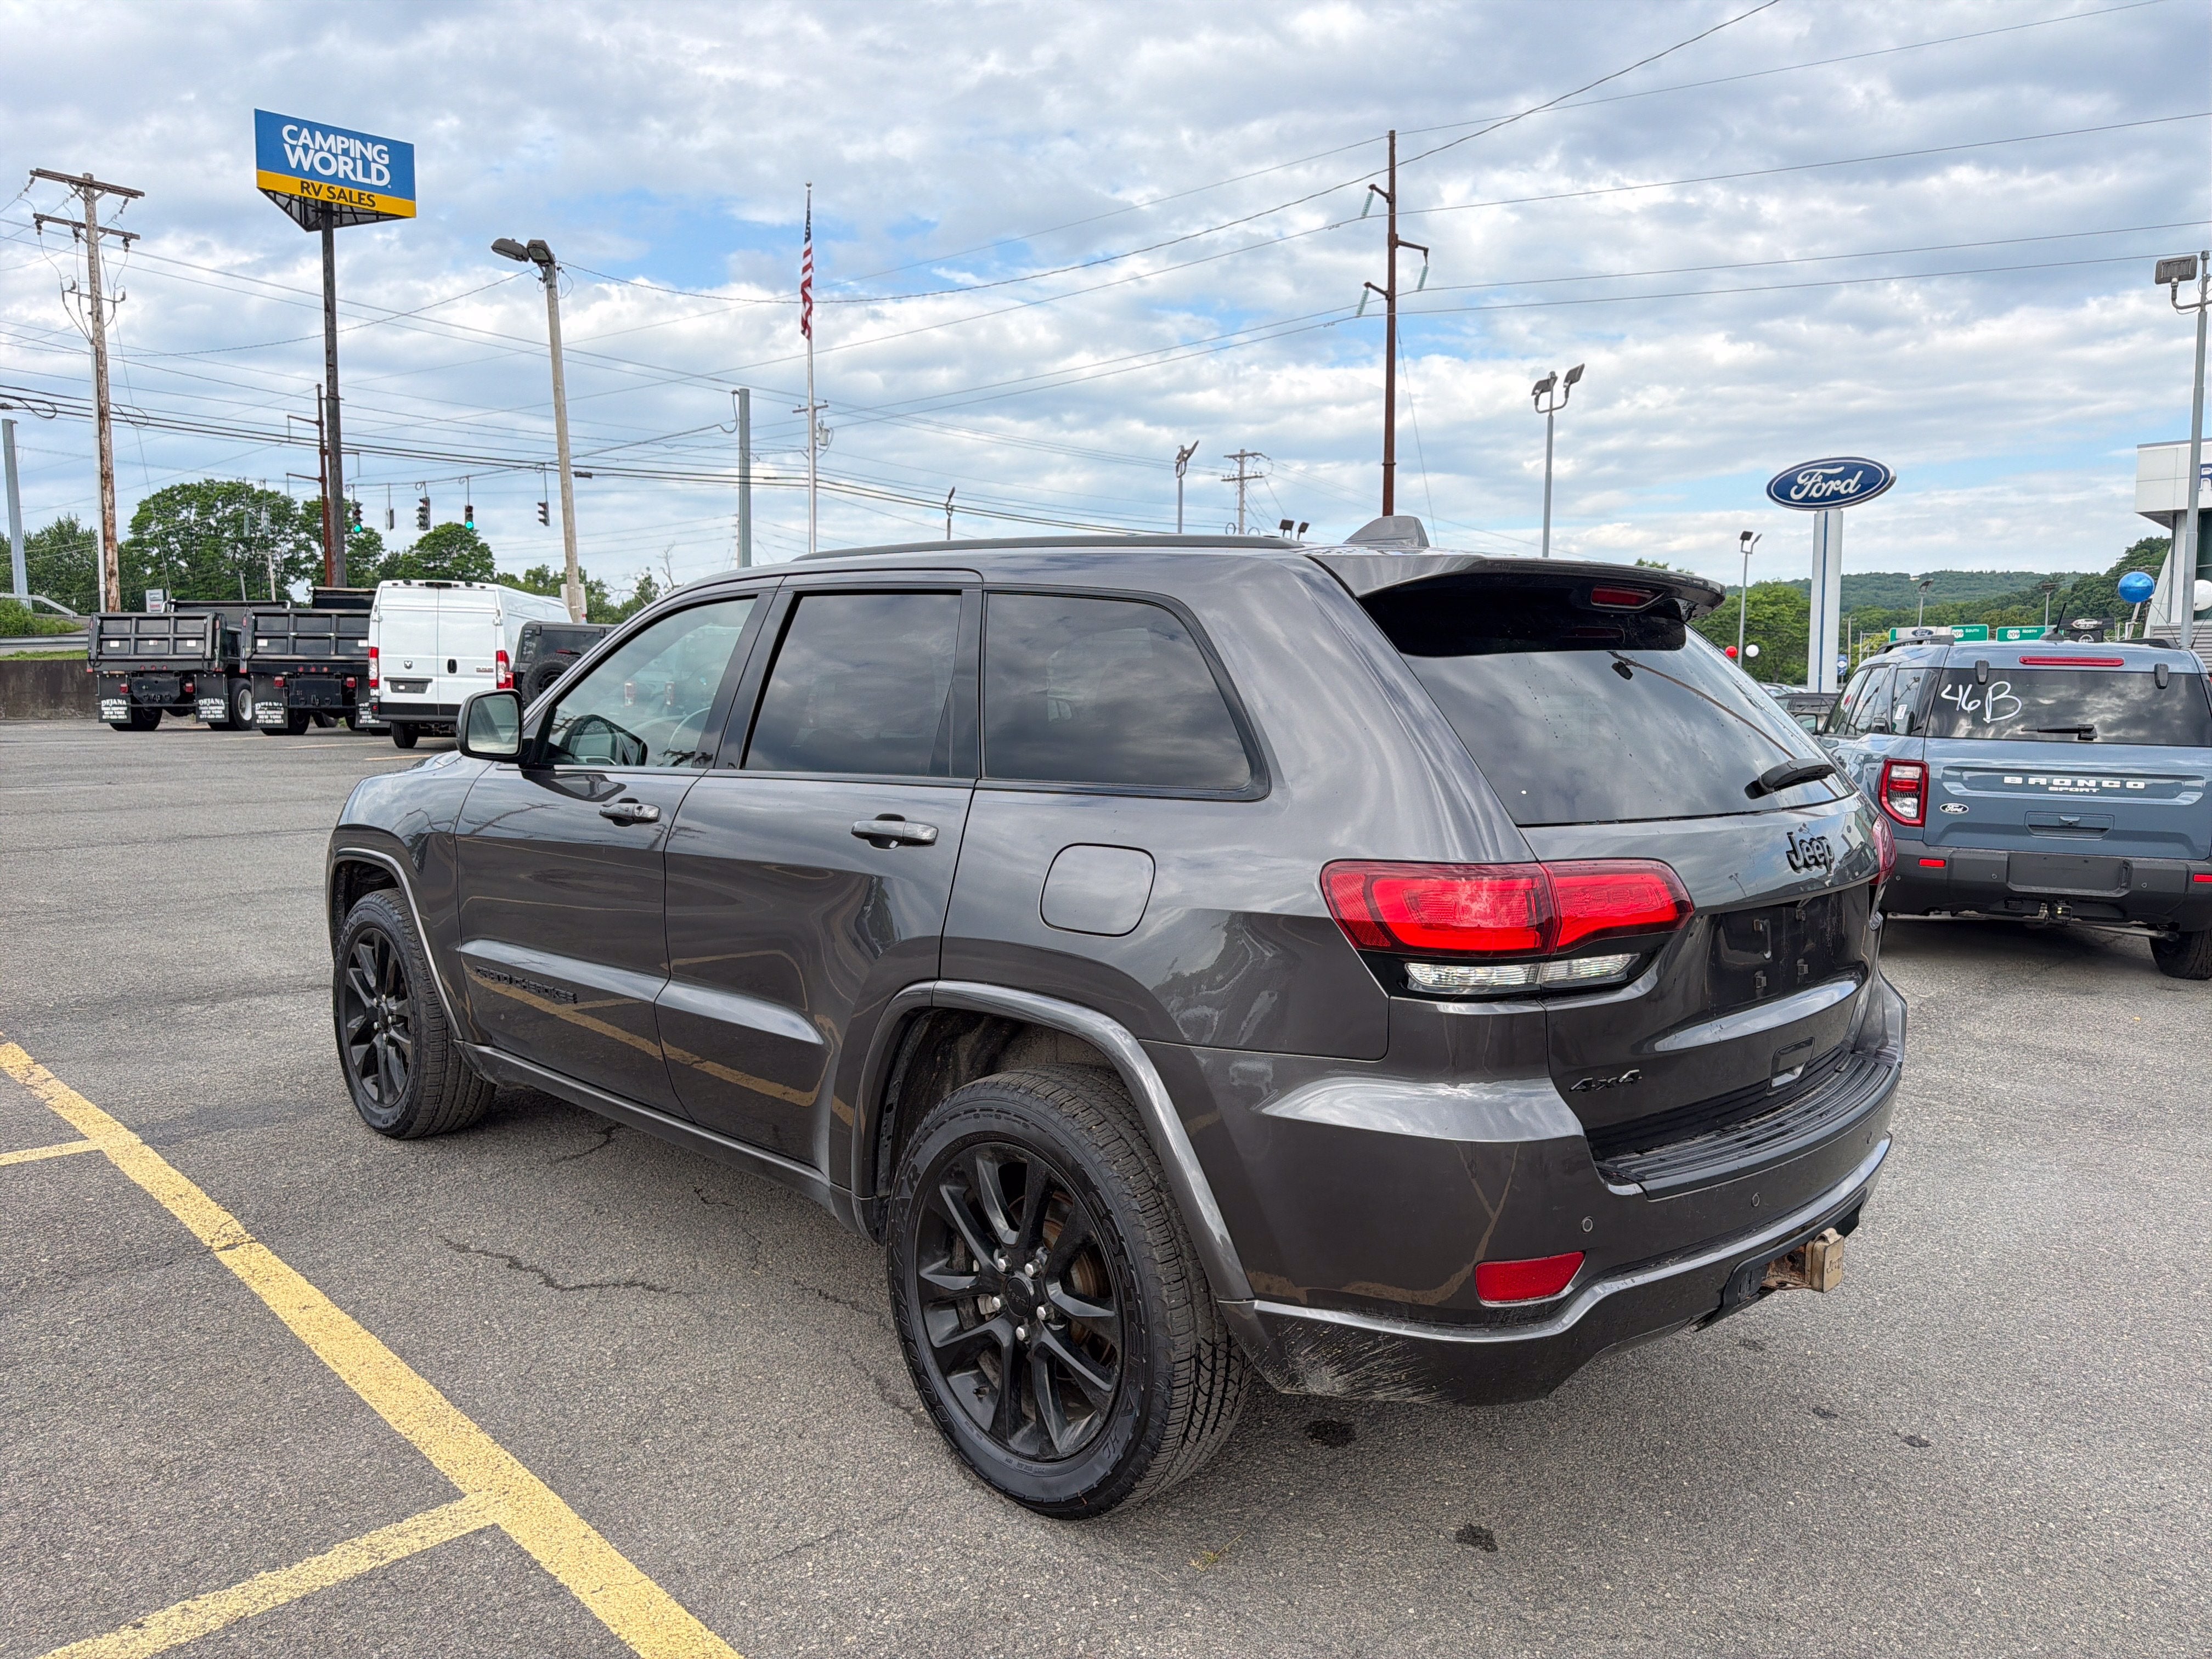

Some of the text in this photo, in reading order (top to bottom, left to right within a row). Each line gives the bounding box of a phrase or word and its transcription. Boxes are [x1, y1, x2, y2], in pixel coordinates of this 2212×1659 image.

[282, 124, 390, 165] CAMPING
[283, 143, 391, 187] WORLD
[300, 180, 376, 208] RV SALES
[1790, 466, 1864, 500] Ford
[101, 698, 127, 707] DEJANA
[199, 698, 225, 707] DEJANA
[2004, 776, 2145, 789] BRONCO
[1945, 804, 1964, 812] Ford
[1785, 831, 1835, 874] Jeep
[475, 966, 577, 1003] GRAND CHEROKEE
